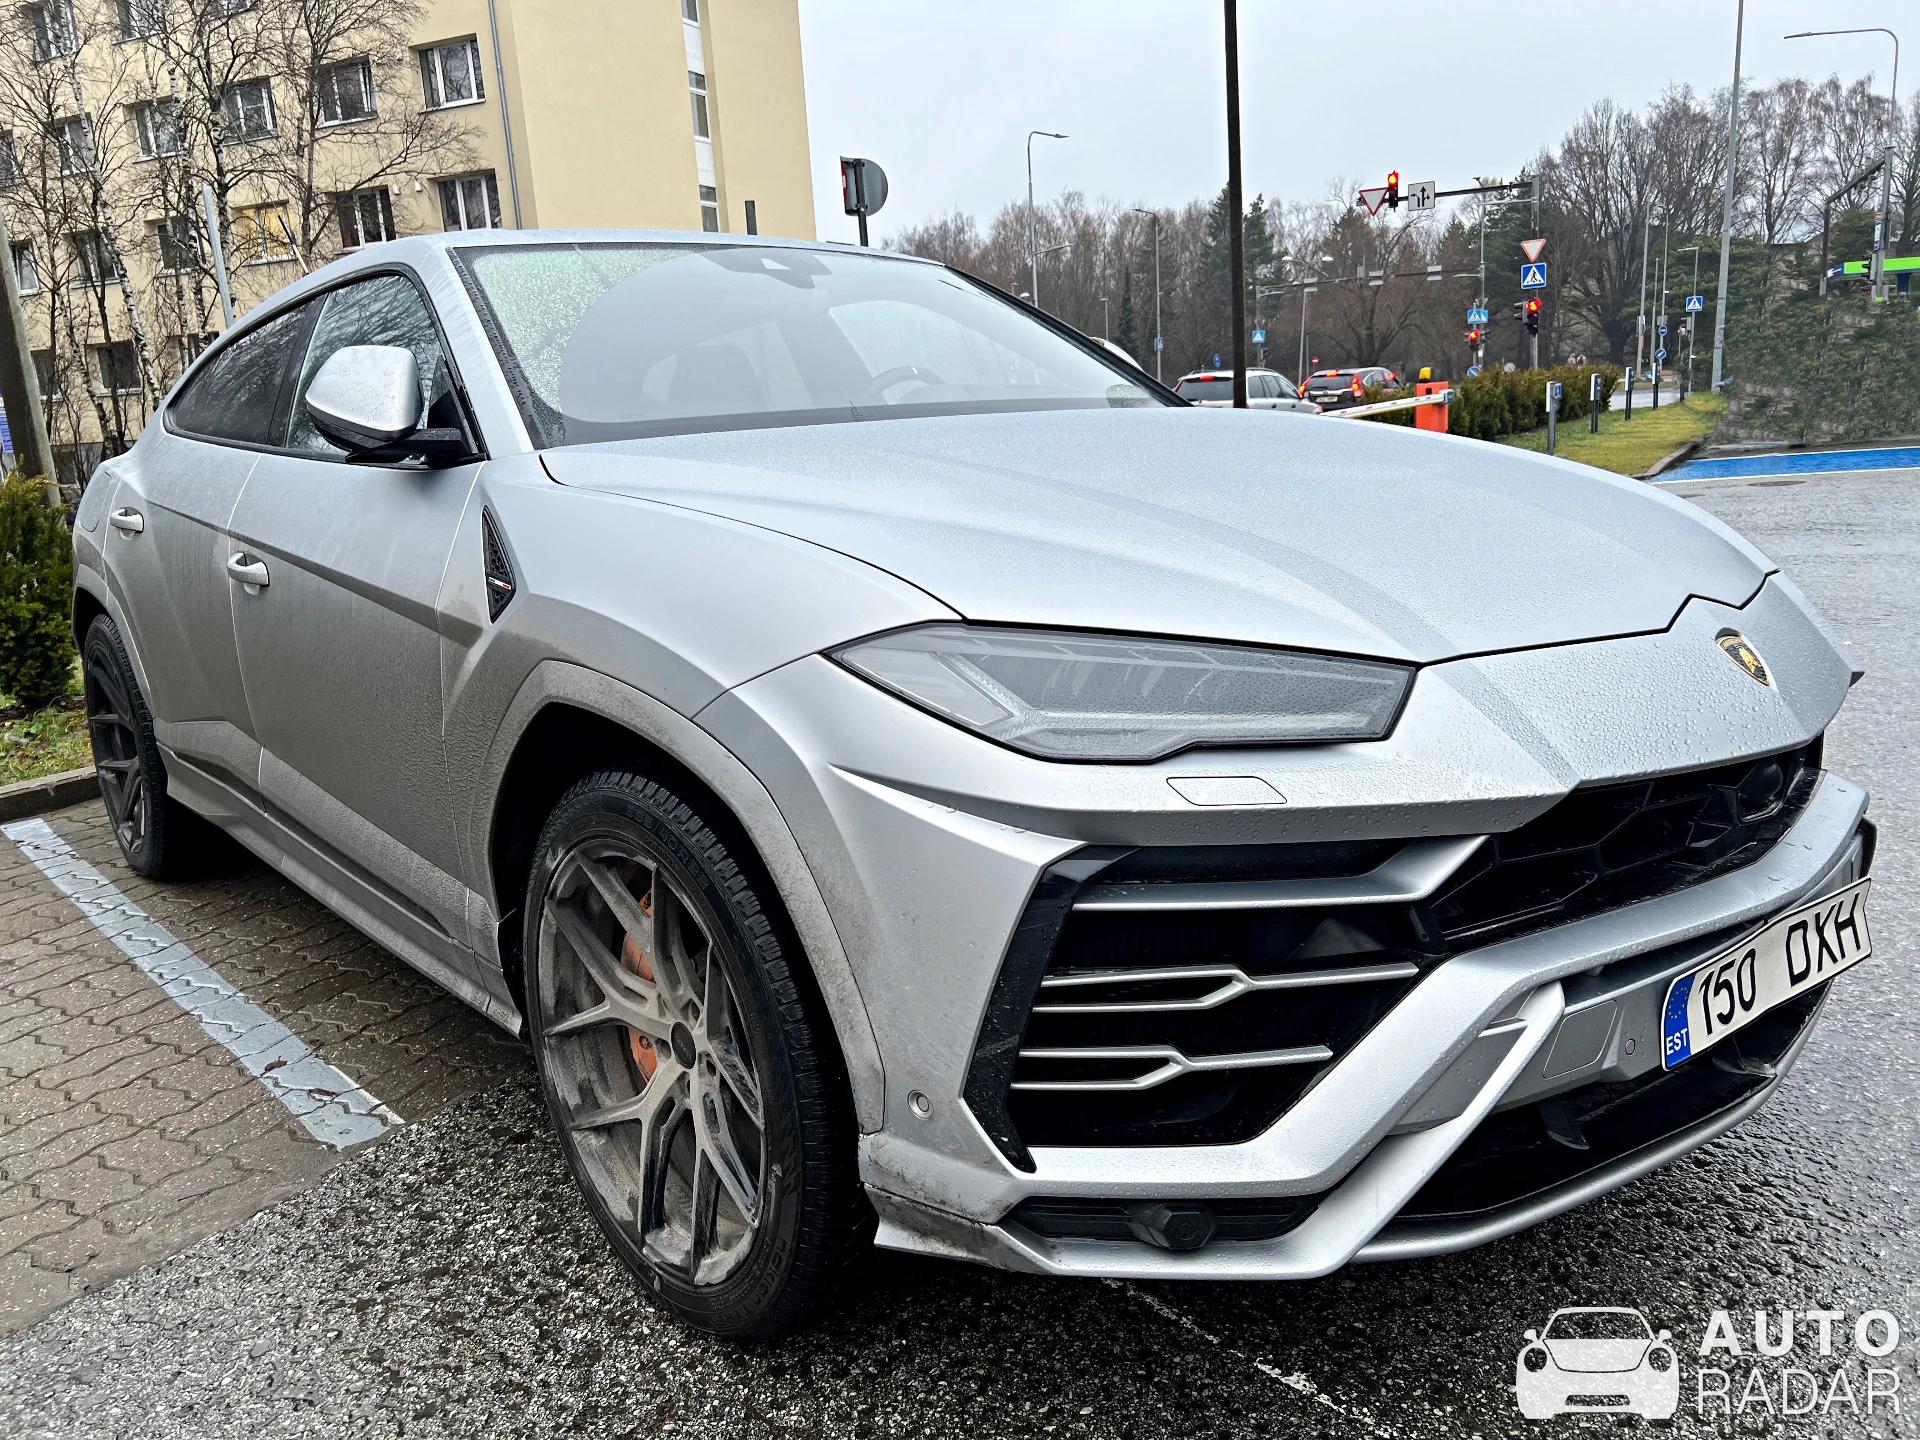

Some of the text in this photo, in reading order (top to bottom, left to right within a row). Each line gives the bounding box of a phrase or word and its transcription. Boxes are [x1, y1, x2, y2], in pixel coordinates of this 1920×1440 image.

[1698, 892, 1861, 1036] 150 DXH
[1666, 1028, 1688, 1055] EST
